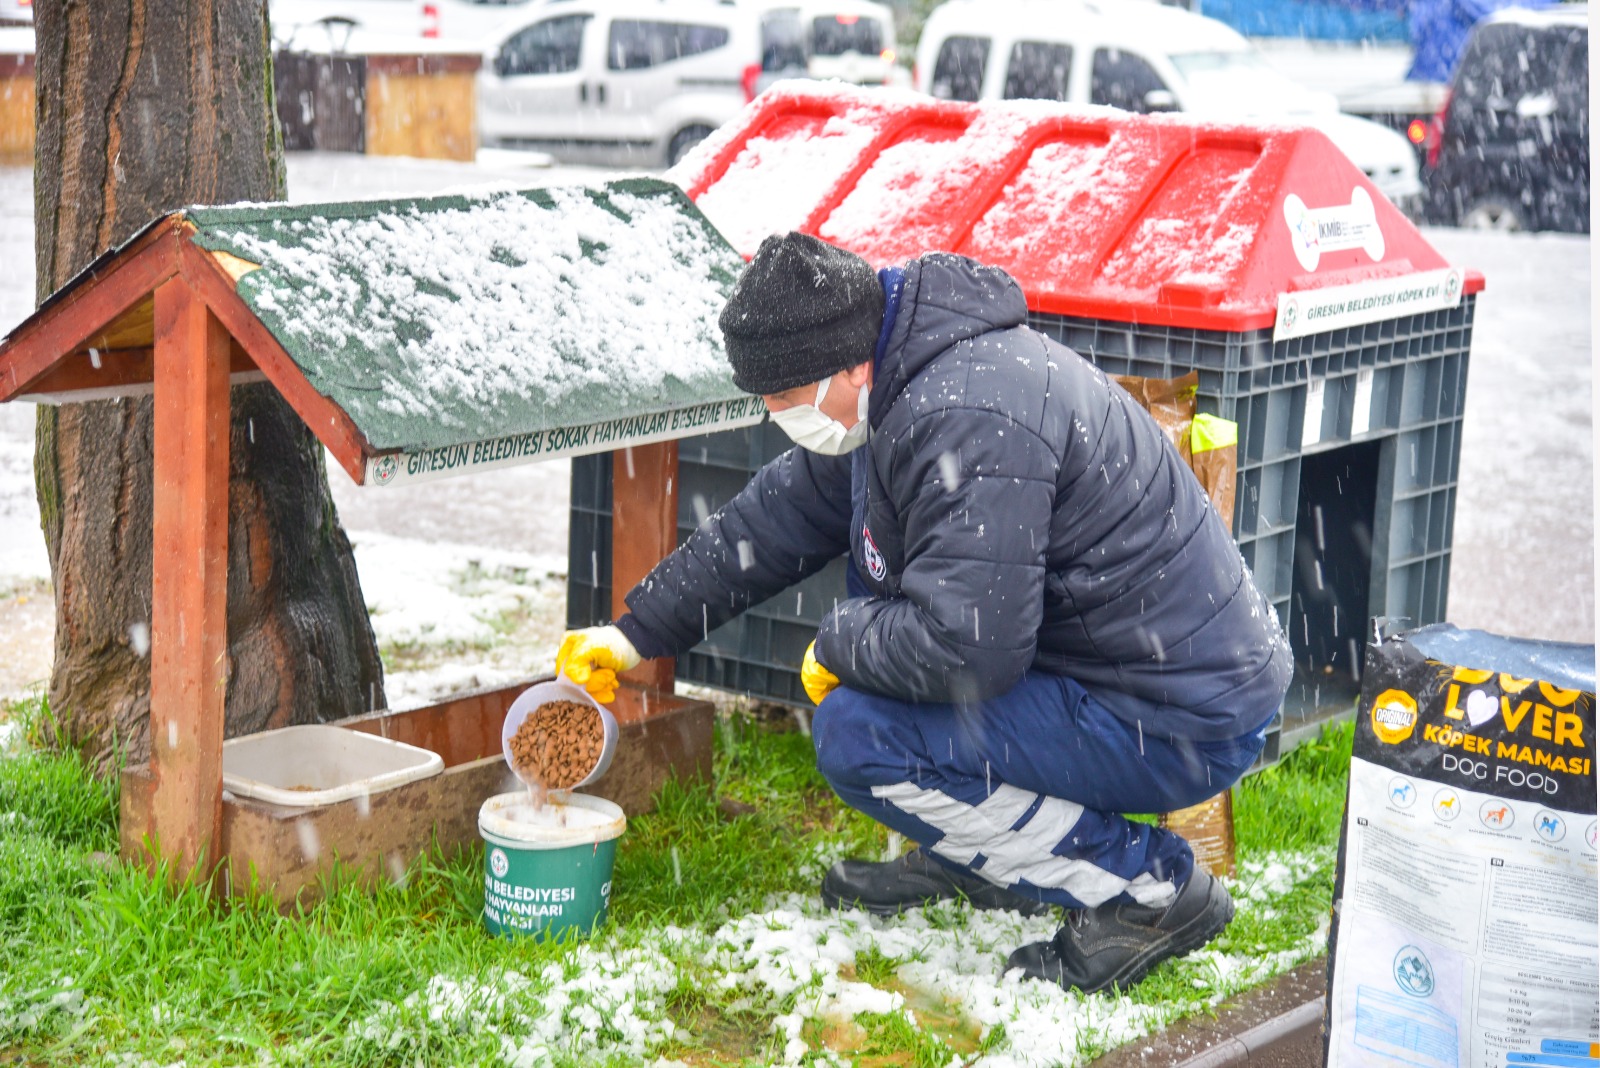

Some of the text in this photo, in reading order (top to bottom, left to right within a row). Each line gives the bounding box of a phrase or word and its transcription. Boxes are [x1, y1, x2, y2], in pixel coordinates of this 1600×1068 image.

[1307, 284, 1440, 320] GİRESUN BELEDİYESİ KÖPEK EVİ
[546, 423, 593, 452] SOKAK
[592, 410, 670, 444] HAYVANLARI
[671, 402, 722, 431] BESLEME
[1376, 708, 1414, 727] ORIGINAL
[1423, 723, 1591, 776] KÖPEK MAMASI
[1442, 753, 1559, 795] DOG FOOD
[488, 893, 563, 917] HAYVANLARI
